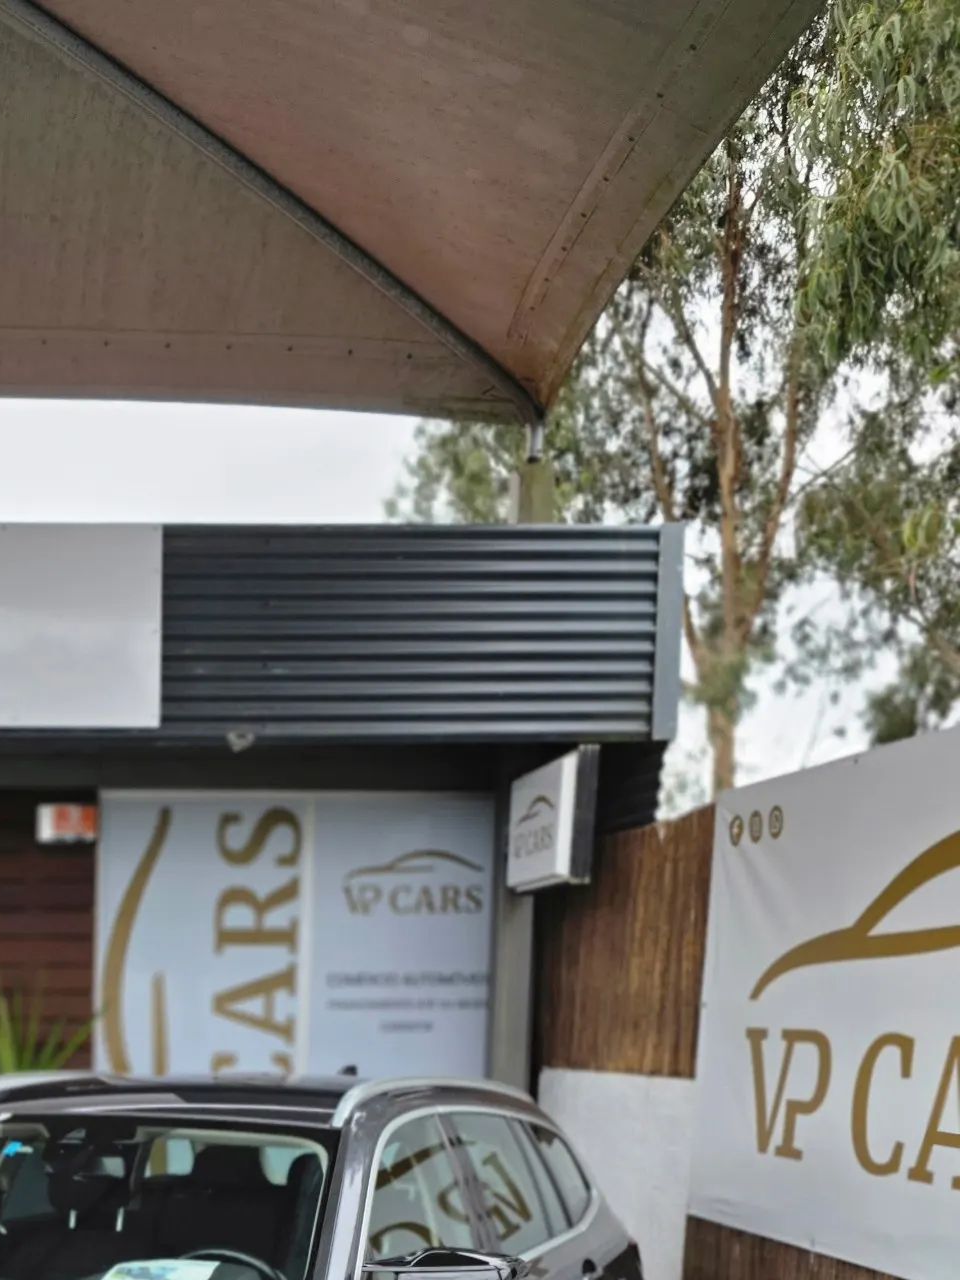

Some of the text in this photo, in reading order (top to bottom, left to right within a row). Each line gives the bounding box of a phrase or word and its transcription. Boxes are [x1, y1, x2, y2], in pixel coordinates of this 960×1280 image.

[343, 883, 484, 917] VP CARS
[745, 1027, 832, 1161] VP
